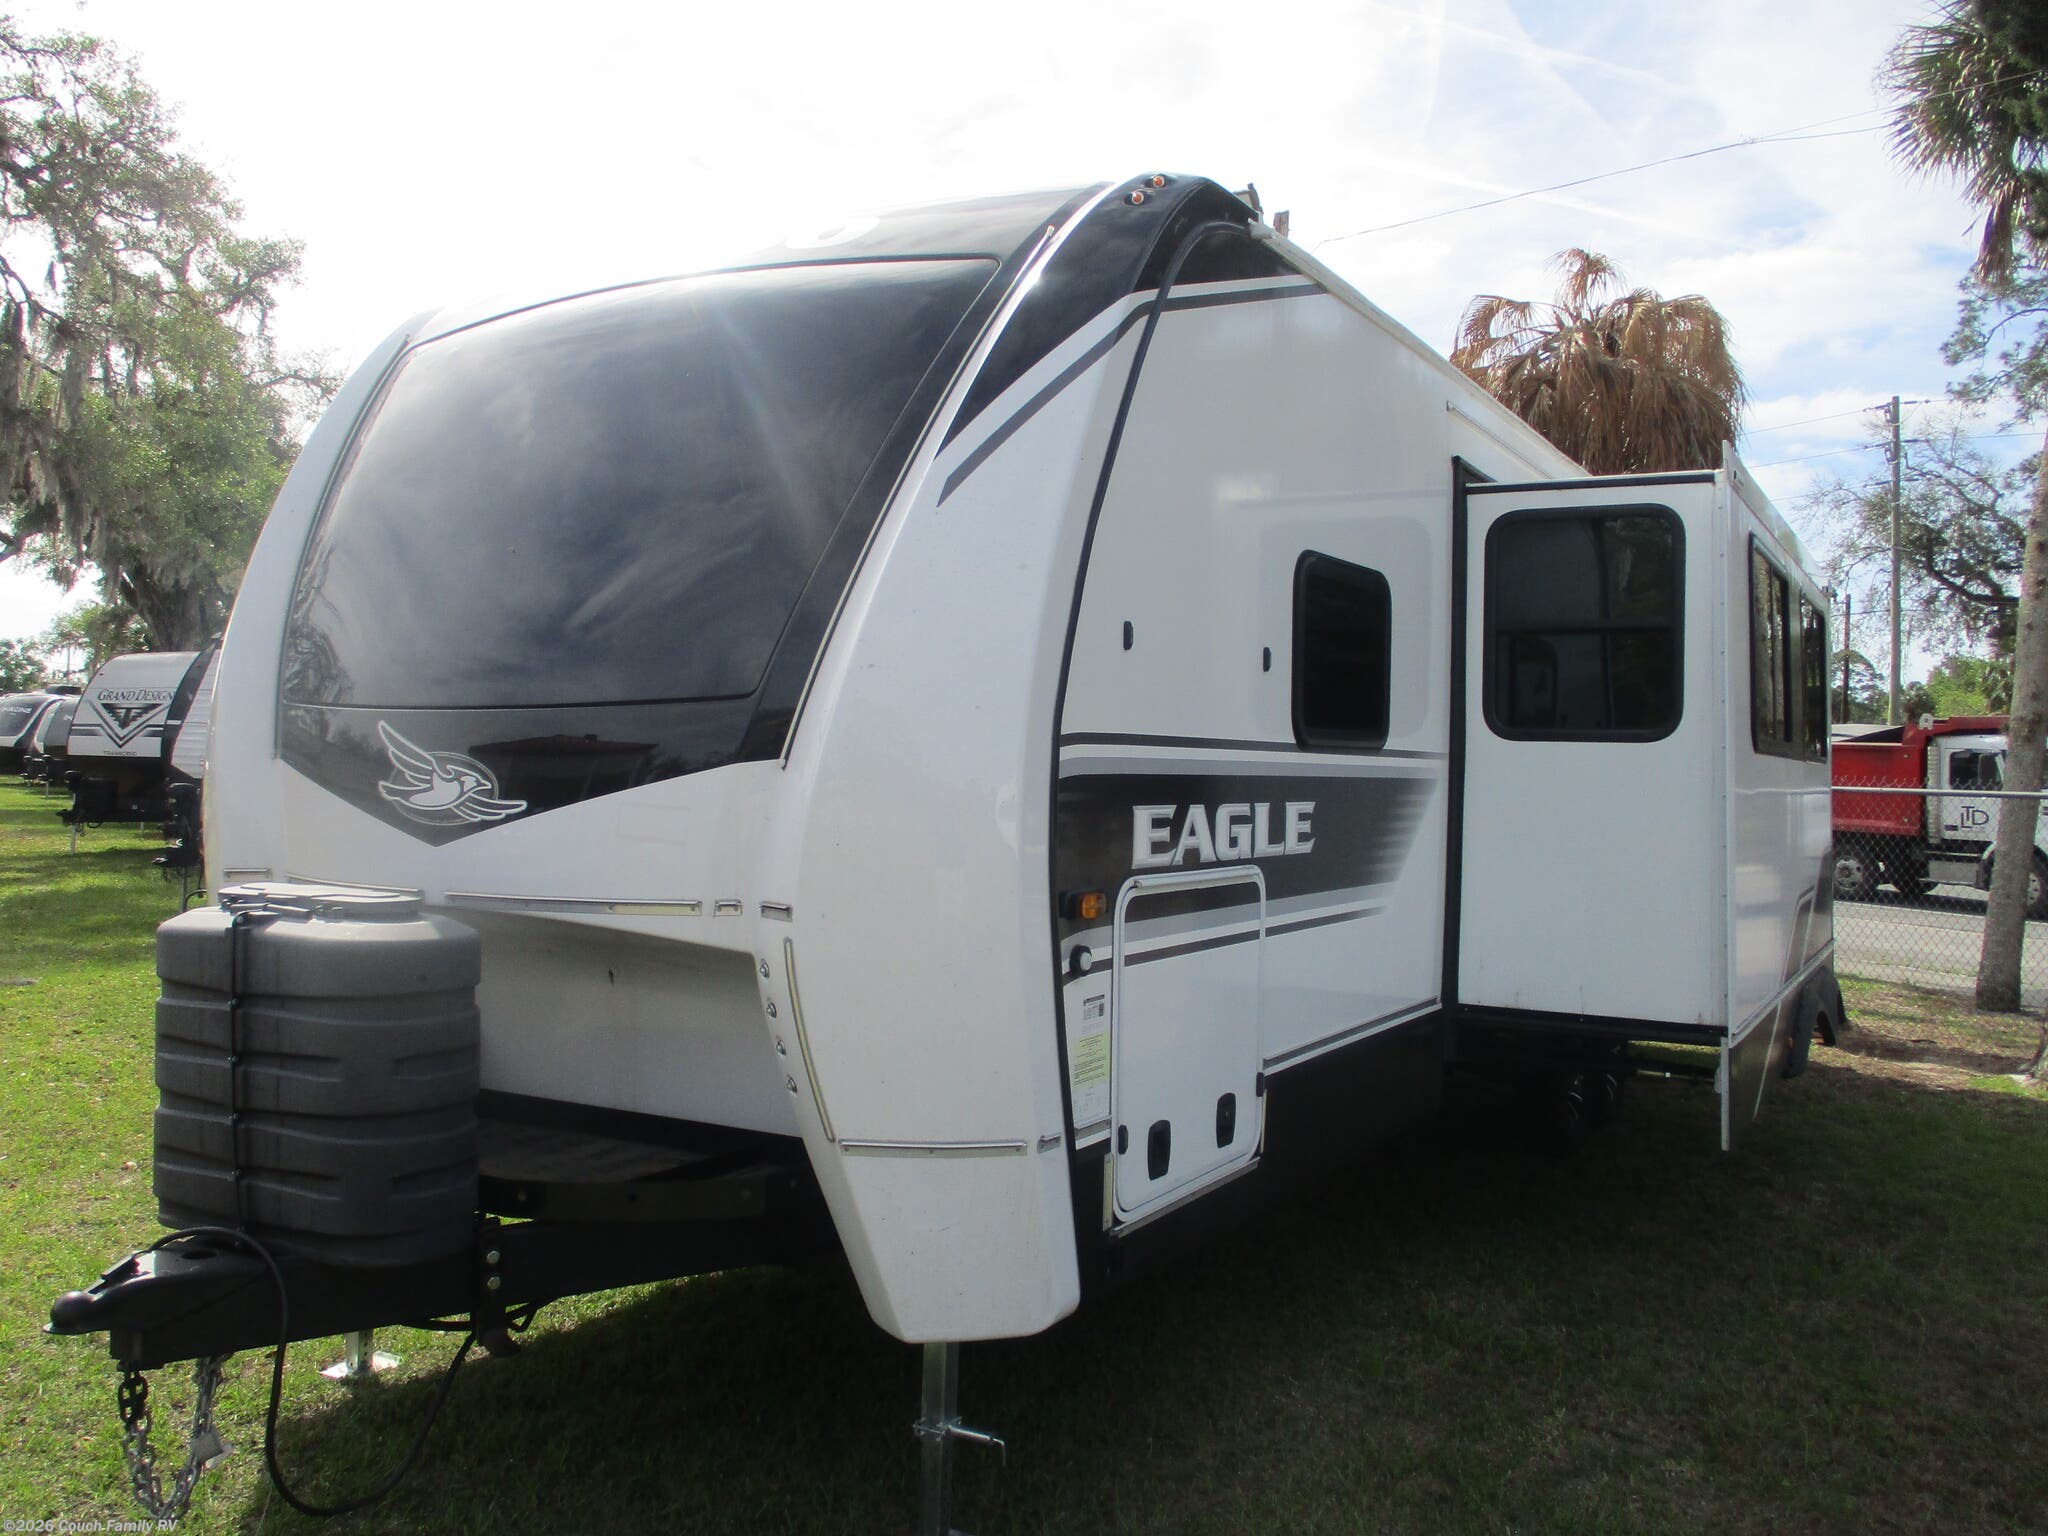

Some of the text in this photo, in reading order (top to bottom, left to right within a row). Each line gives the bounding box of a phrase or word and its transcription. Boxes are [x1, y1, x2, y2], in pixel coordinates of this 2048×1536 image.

[98, 688, 173, 701] GRAND DESIGN
[1132, 802, 1316, 869] EAGLE
